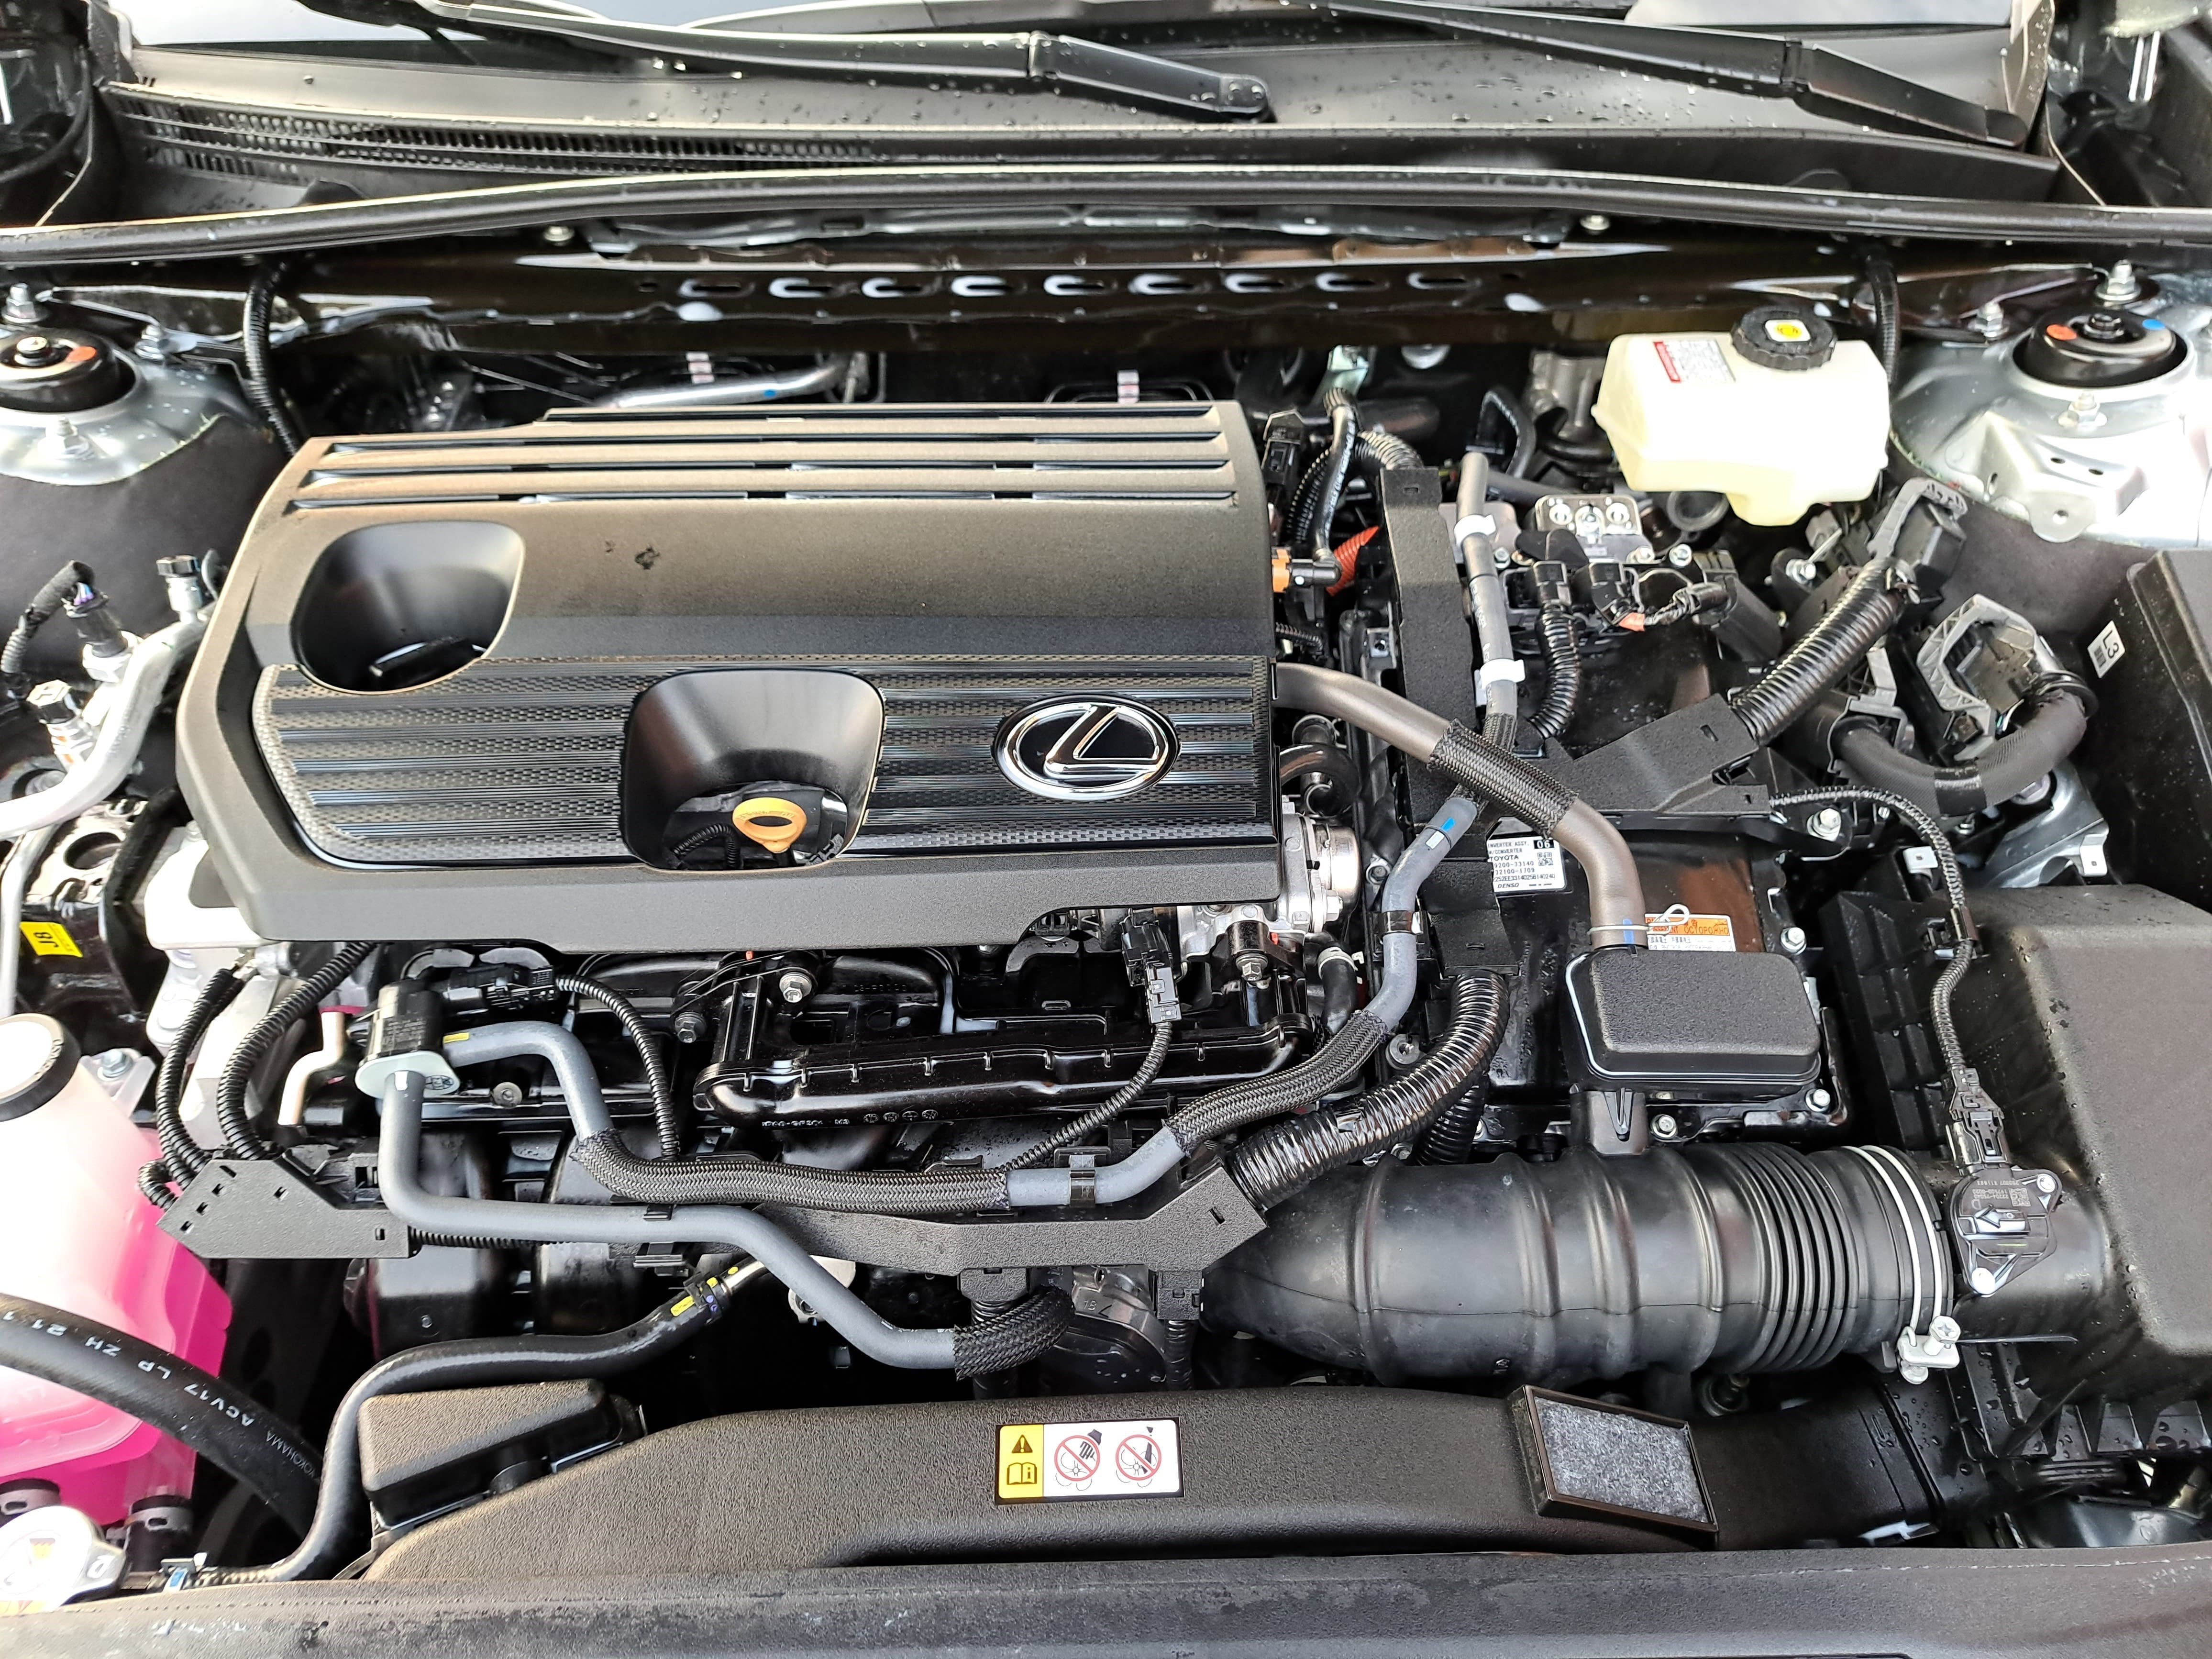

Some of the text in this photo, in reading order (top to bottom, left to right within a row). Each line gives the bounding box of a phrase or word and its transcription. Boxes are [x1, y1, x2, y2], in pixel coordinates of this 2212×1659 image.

[2102, 630, 2119, 659] L3
[1537, 840, 1551, 849] 06
[33, 932, 58, 948] J8
[85, 1336, 122, 1357] ZH
[138, 1360, 171, 1380] LP
[184, 1383, 255, 1427] ACV17
[265, 1430, 318, 1478] YOKOHAMA
